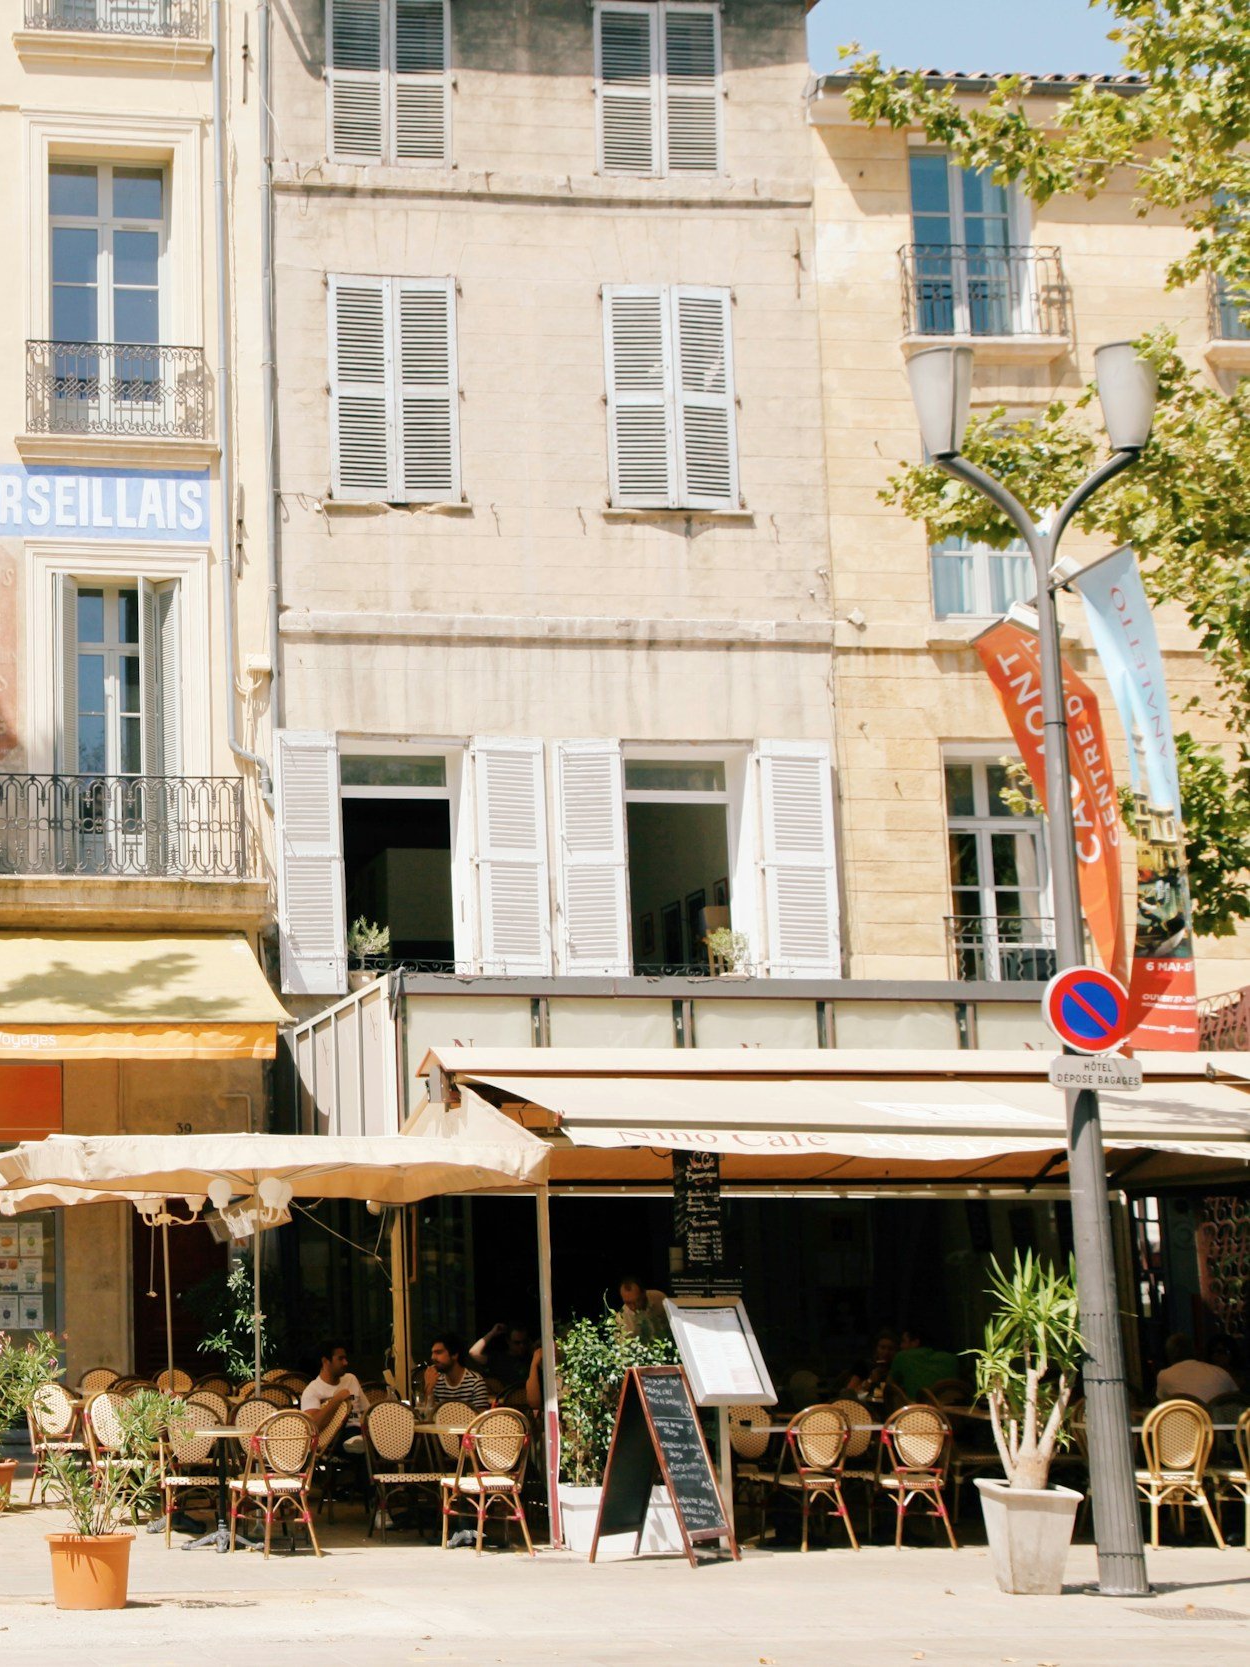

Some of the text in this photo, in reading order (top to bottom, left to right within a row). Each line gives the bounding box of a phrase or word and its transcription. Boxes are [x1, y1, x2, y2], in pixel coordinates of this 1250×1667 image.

[1077, 723, 1119, 847] CENTRE
[1145, 962, 1155, 972] 6
[1084, 1061, 1113, 1073] HÔTEL
[1057, 1072, 1140, 1086] DÉPOSE BAGAGES
[176, 1123, 192, 1134] 39
[618, 1130, 718, 1144] Nino
